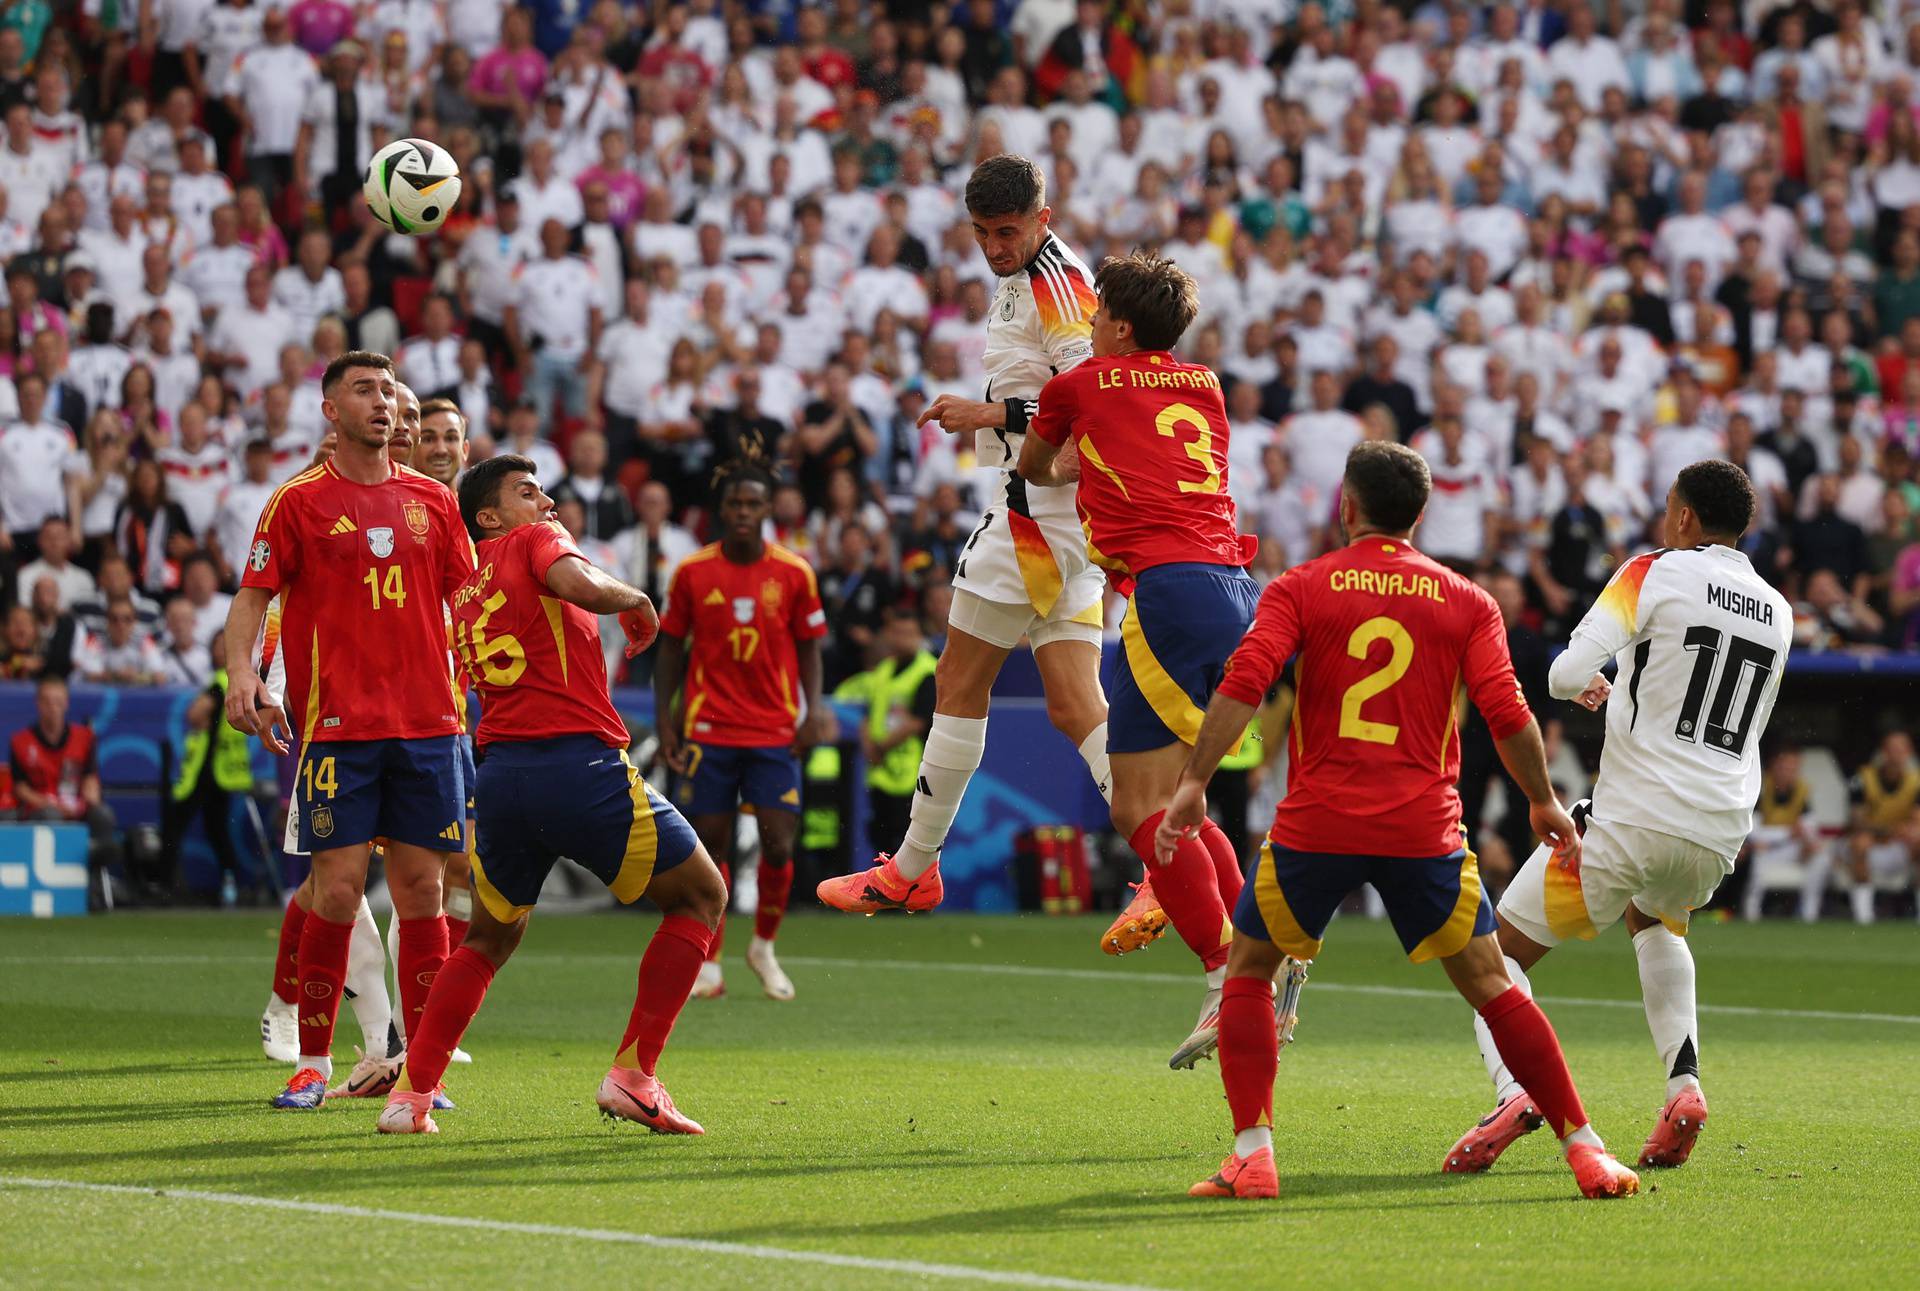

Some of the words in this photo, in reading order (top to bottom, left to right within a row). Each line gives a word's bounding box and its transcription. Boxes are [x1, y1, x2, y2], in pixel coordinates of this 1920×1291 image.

[1098, 368, 1124, 390] LE
[1155, 402, 1220, 493] 3
[363, 565, 407, 610] 14
[1330, 568, 1446, 603] CARVAJAL
[1707, 582, 1773, 626] MUSIALA
[727, 626, 761, 663] 17
[1340, 616, 1415, 746] 2
[1675, 625, 1777, 761] 10
[303, 756, 339, 802] 14
